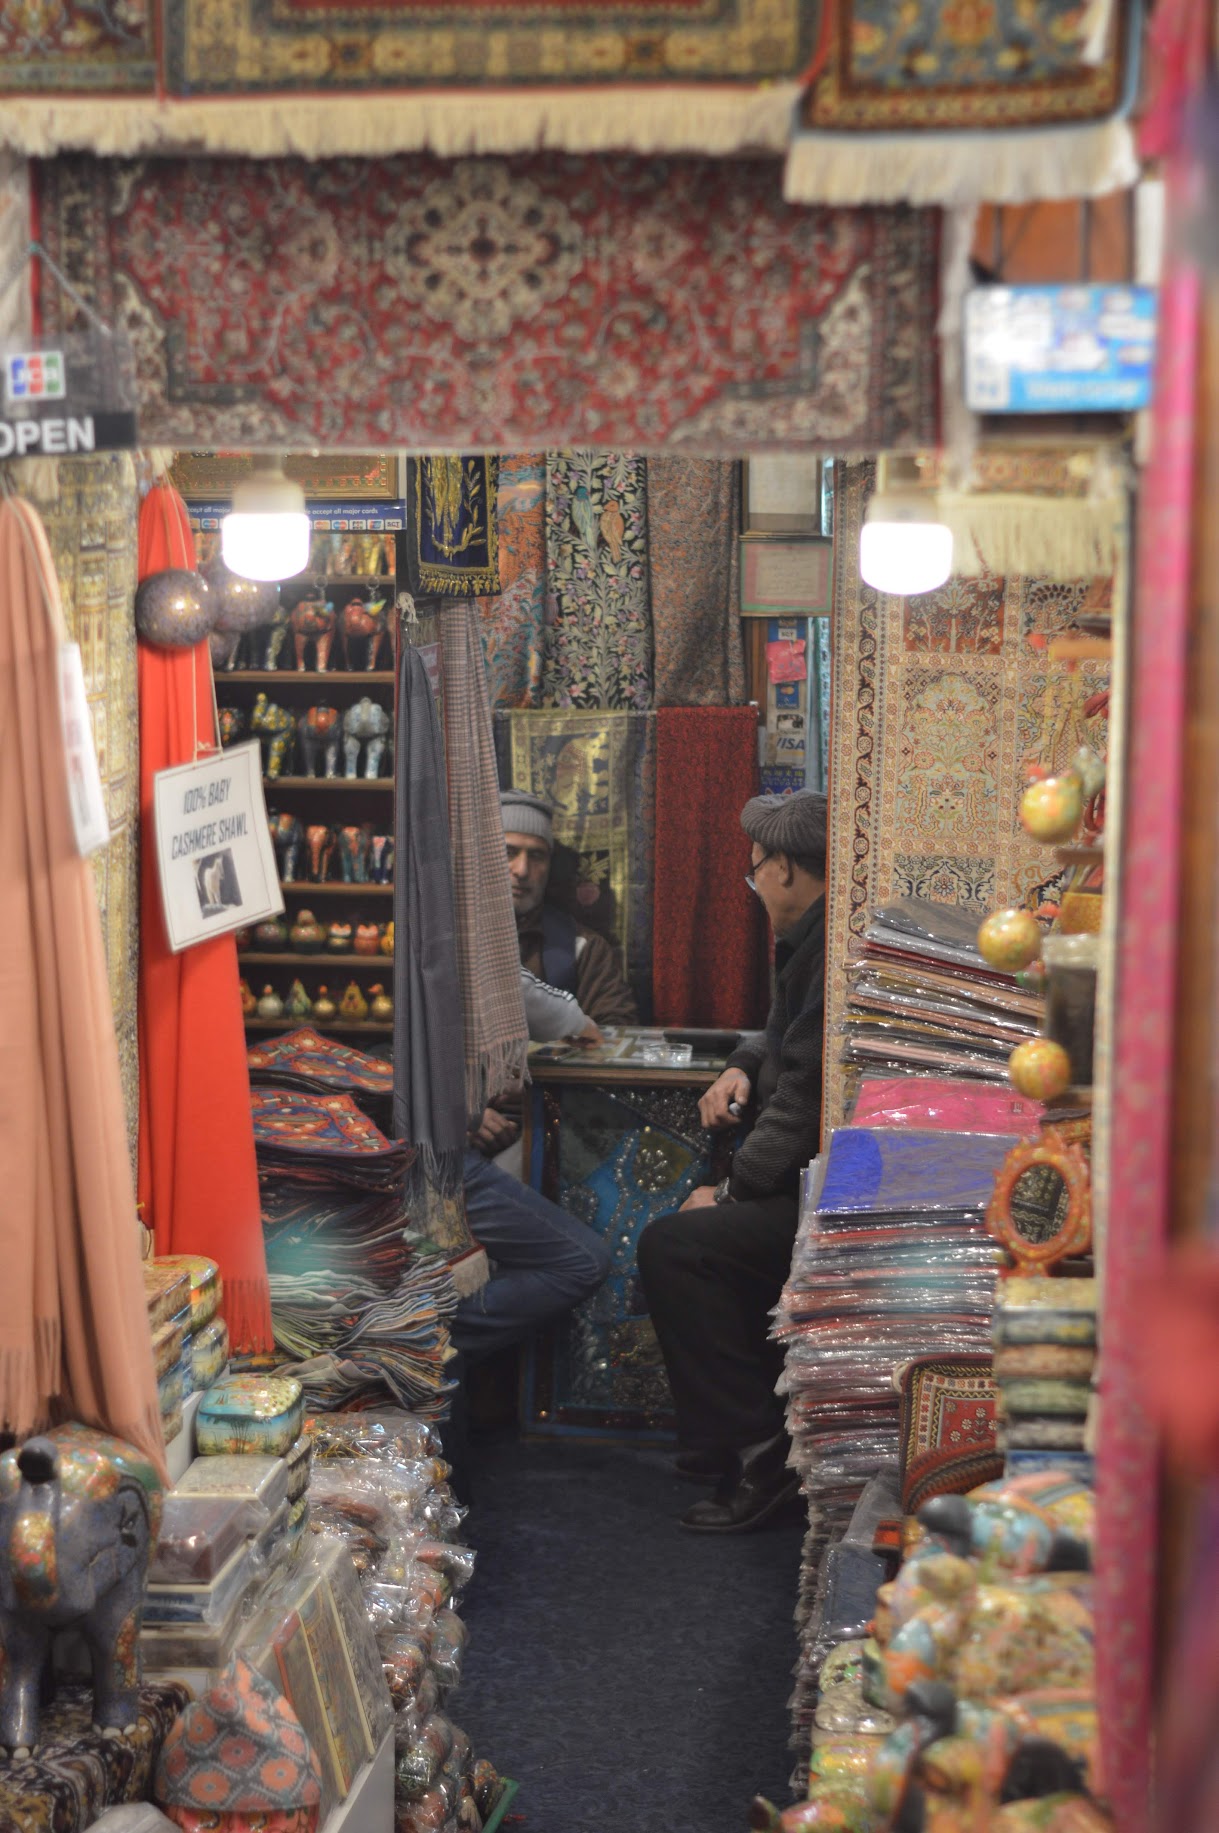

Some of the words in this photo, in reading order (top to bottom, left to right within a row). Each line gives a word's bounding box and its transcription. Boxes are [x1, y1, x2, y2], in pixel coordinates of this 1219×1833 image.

[343, 507, 360, 515] major
[183, 784, 207, 815] 100%
[208, 777, 232, 807] BABY
[171, 821, 217, 860] CASHMERE
[219, 812, 248, 843] SHAWL
